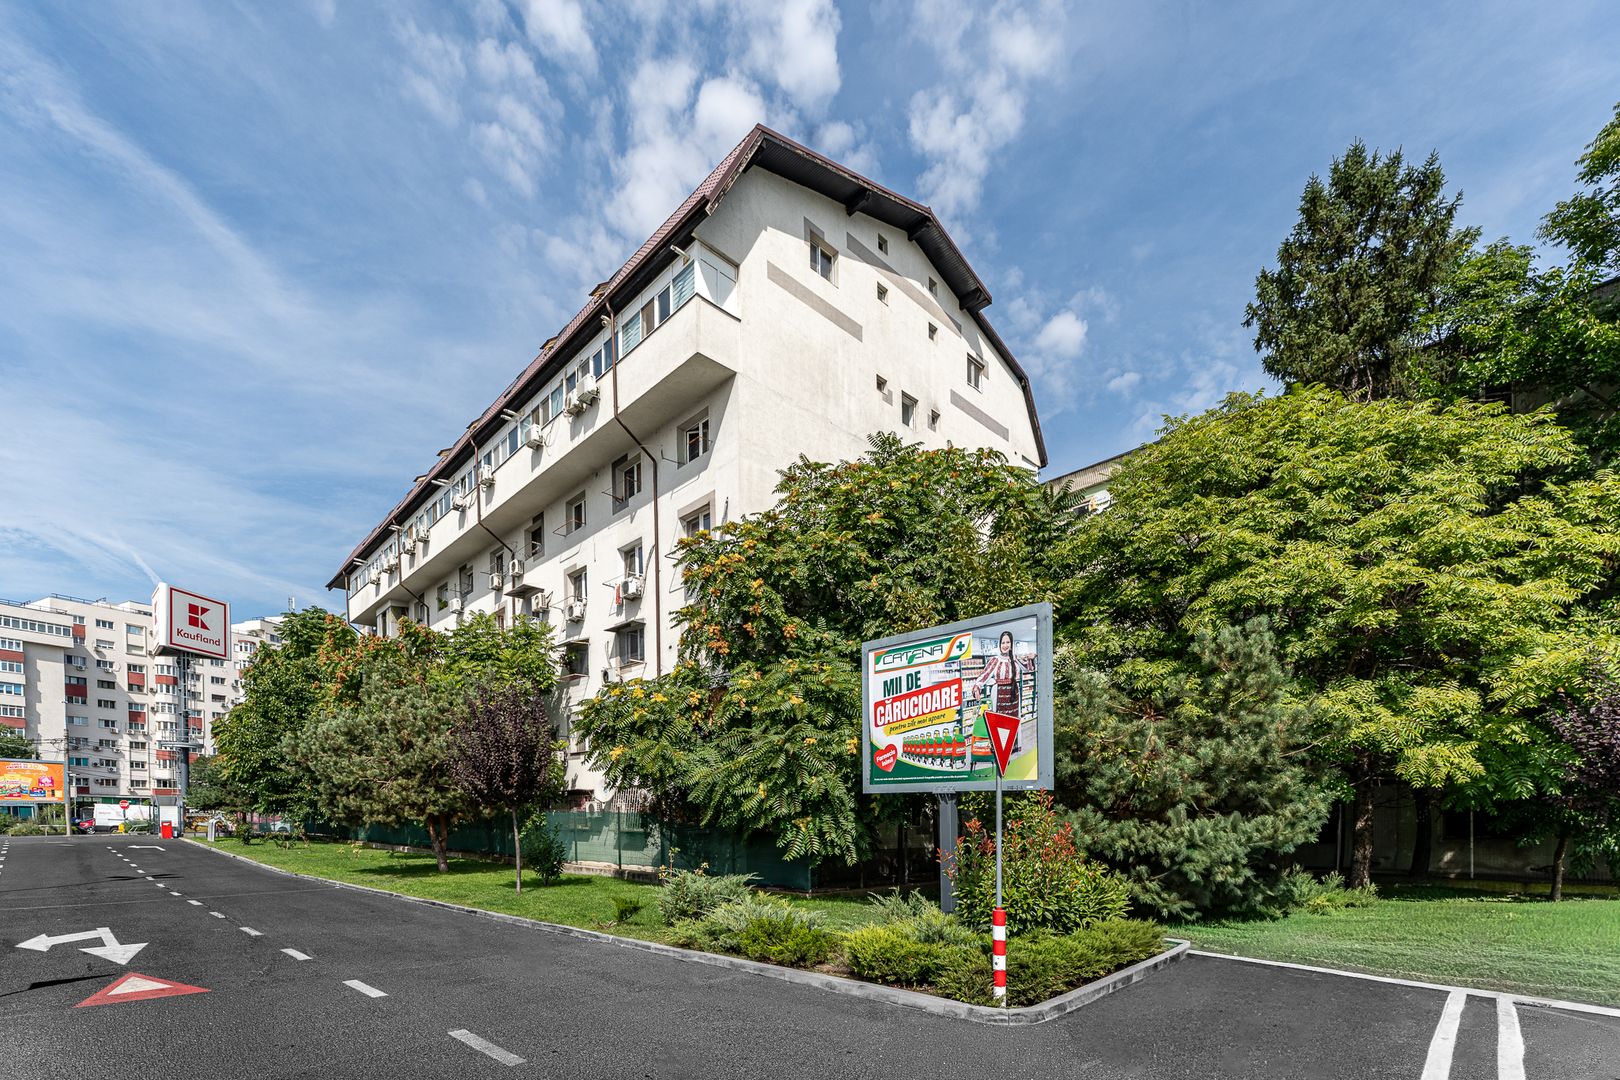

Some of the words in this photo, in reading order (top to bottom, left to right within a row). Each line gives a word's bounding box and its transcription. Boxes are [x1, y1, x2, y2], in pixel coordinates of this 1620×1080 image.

[177, 628, 220, 646] Kaufland
[883, 645, 944, 664] CATENA
[883, 677, 902, 698] MII
[906, 671, 921, 691] DE
[876, 684, 959, 726] CĂRUCIOARE
